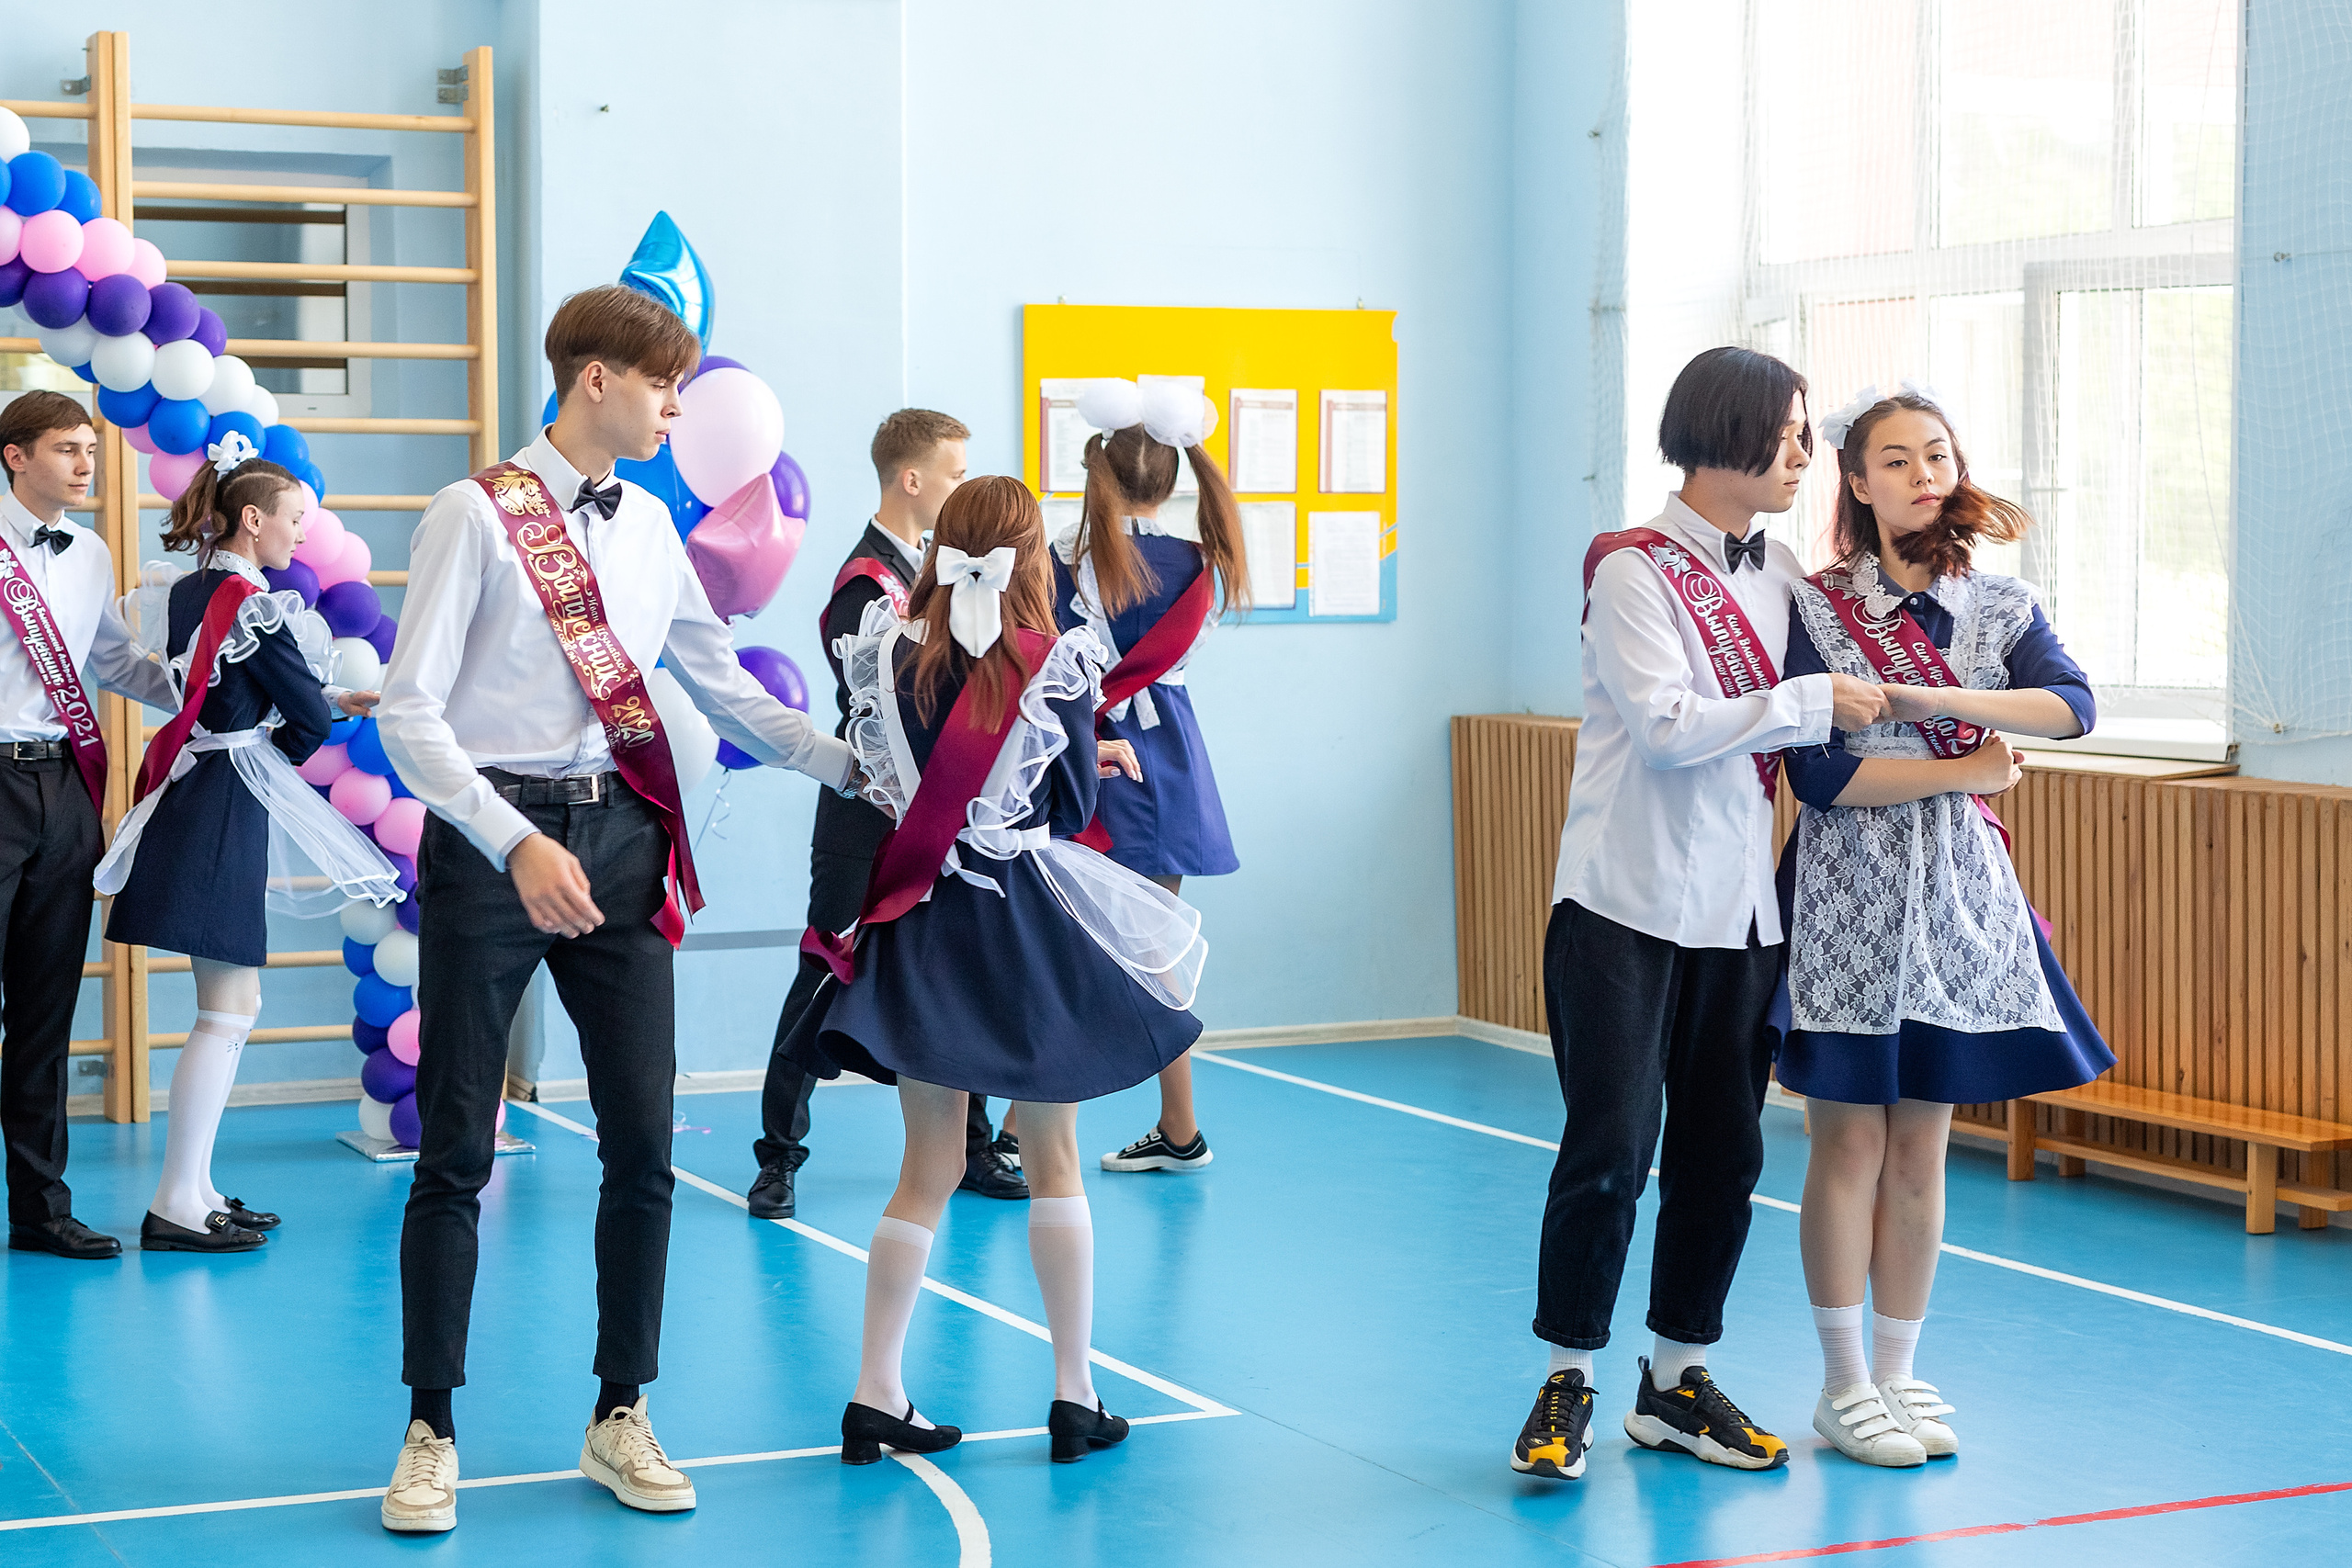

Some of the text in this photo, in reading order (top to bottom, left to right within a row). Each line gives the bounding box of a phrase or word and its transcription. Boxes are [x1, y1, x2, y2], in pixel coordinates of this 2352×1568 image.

[3, 576, 100, 748] Выпускник 2021
[35, 606, 76, 683] Быковский Андрей
[516, 521, 656, 749] Выпускник 2020
[1682, 570, 1756, 696] Выпускни
[1724, 613, 1772, 690] Ким Владимир
[1912, 641, 1949, 687] Сим Ири
[1712, 657, 1729, 676] МБОУ
[1722, 676, 1736, 694] СОШ
